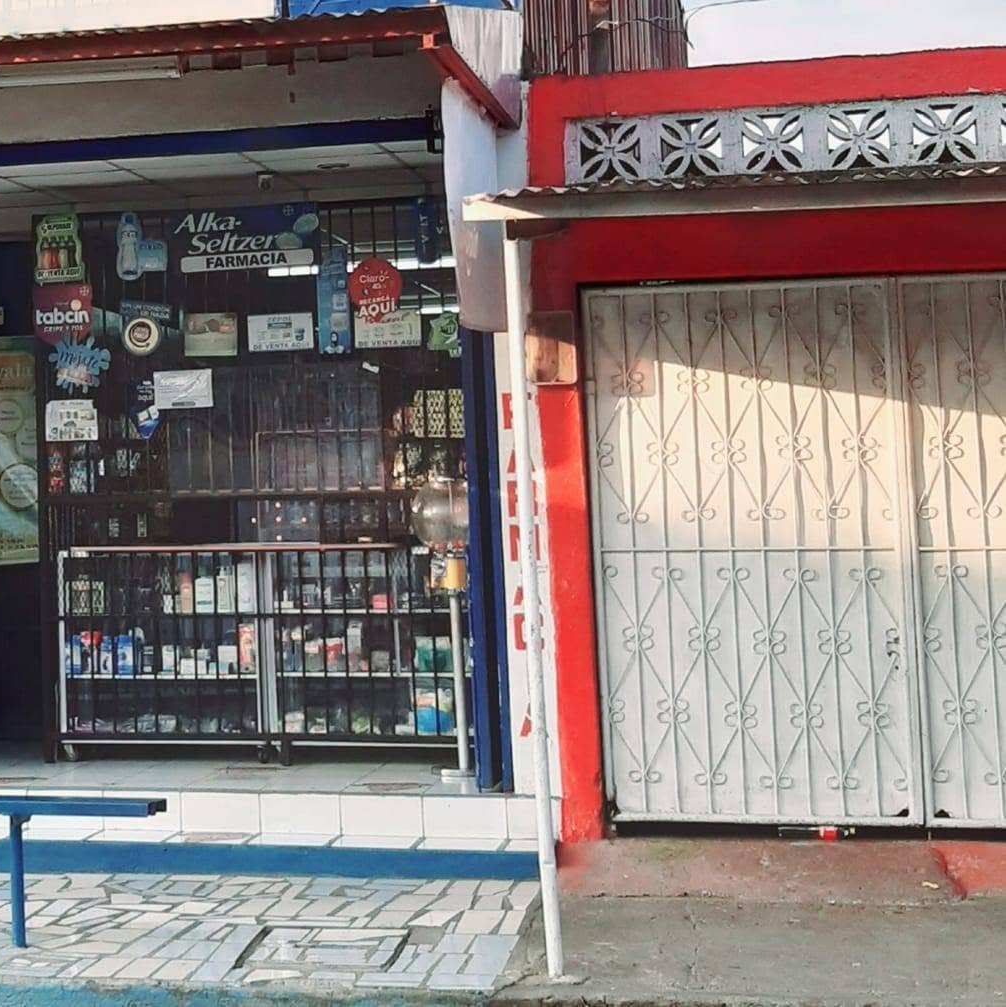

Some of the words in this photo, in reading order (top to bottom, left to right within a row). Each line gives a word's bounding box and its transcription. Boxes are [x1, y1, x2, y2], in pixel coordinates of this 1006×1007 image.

[174, 212, 242, 234] Alka-
[188, 232, 279, 255] Seltzer
[205, 252, 288, 269] FARMACIA
[35, 300, 90, 326] tabcin
